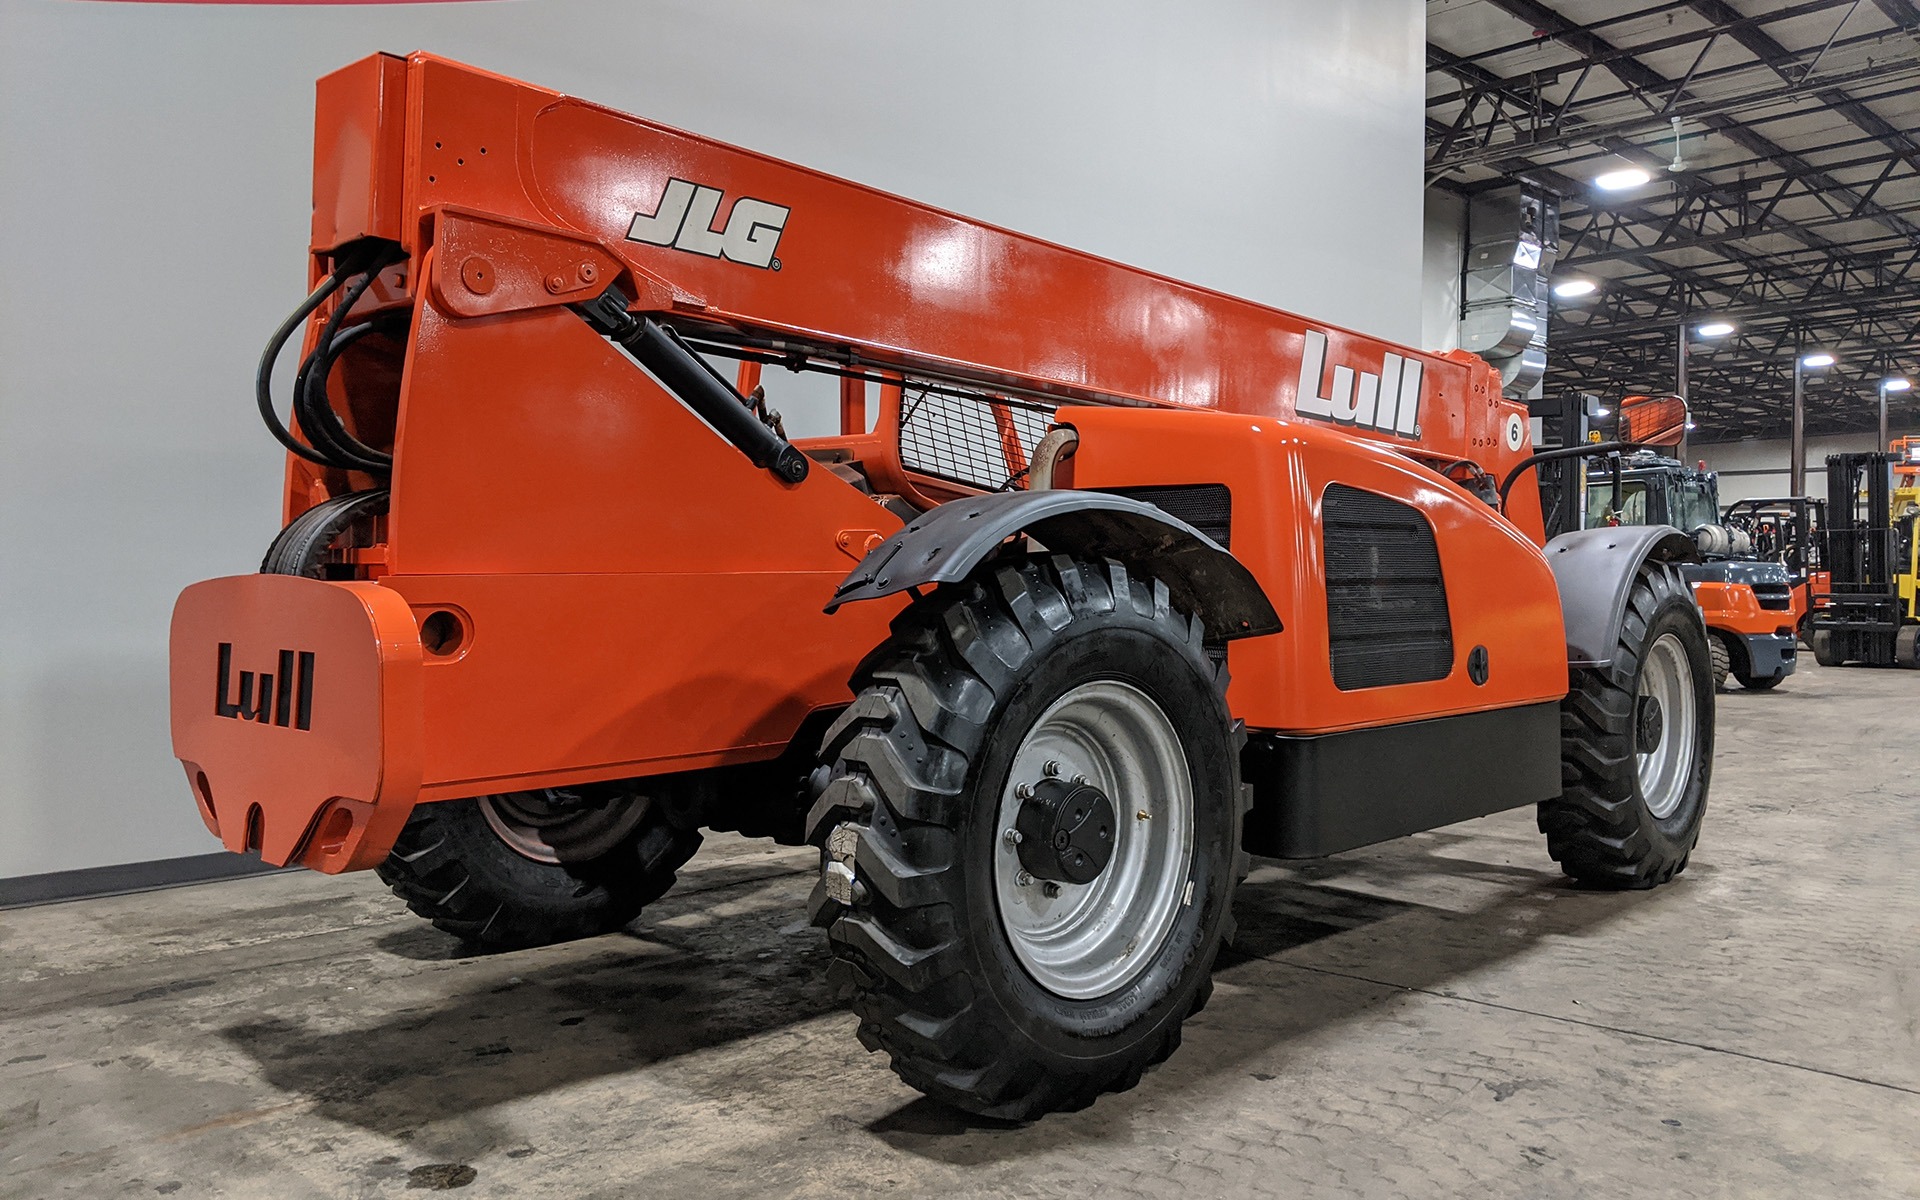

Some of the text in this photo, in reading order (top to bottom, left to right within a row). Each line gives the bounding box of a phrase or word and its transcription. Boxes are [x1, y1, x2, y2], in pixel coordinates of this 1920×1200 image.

[624, 176, 792, 270] JLG
[1295, 328, 1424, 440] Lull
[1511, 423, 1518, 442] 6
[215, 642, 315, 731] Lull
